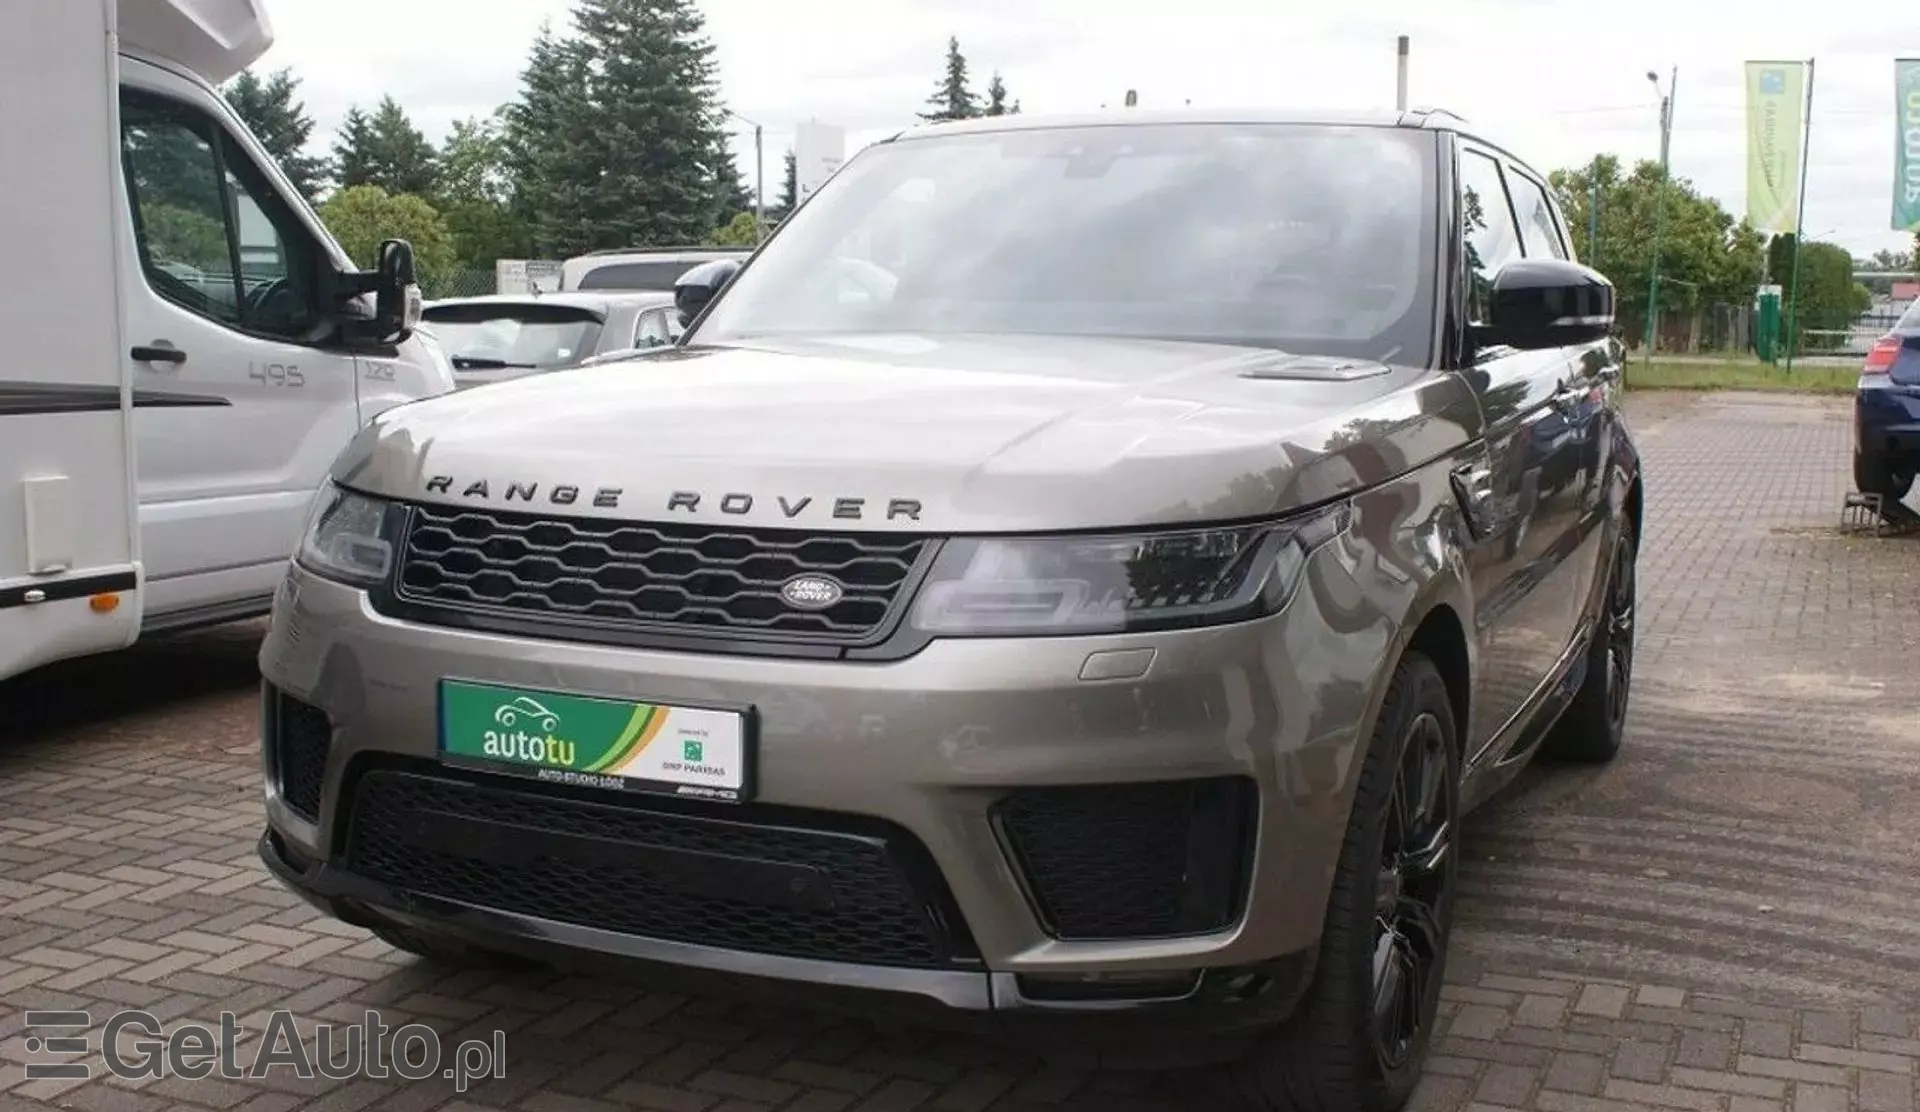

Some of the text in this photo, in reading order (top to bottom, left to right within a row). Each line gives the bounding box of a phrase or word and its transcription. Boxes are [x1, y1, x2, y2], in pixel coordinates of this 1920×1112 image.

[248, 361, 306, 388] 495
[426, 475, 924, 521] RANGE ROVER
[792, 579, 825, 592] LAND
[796, 590, 829, 601] ROVER
[483, 729, 575, 766] autotu
[684, 763, 726, 777] PARIBAS
